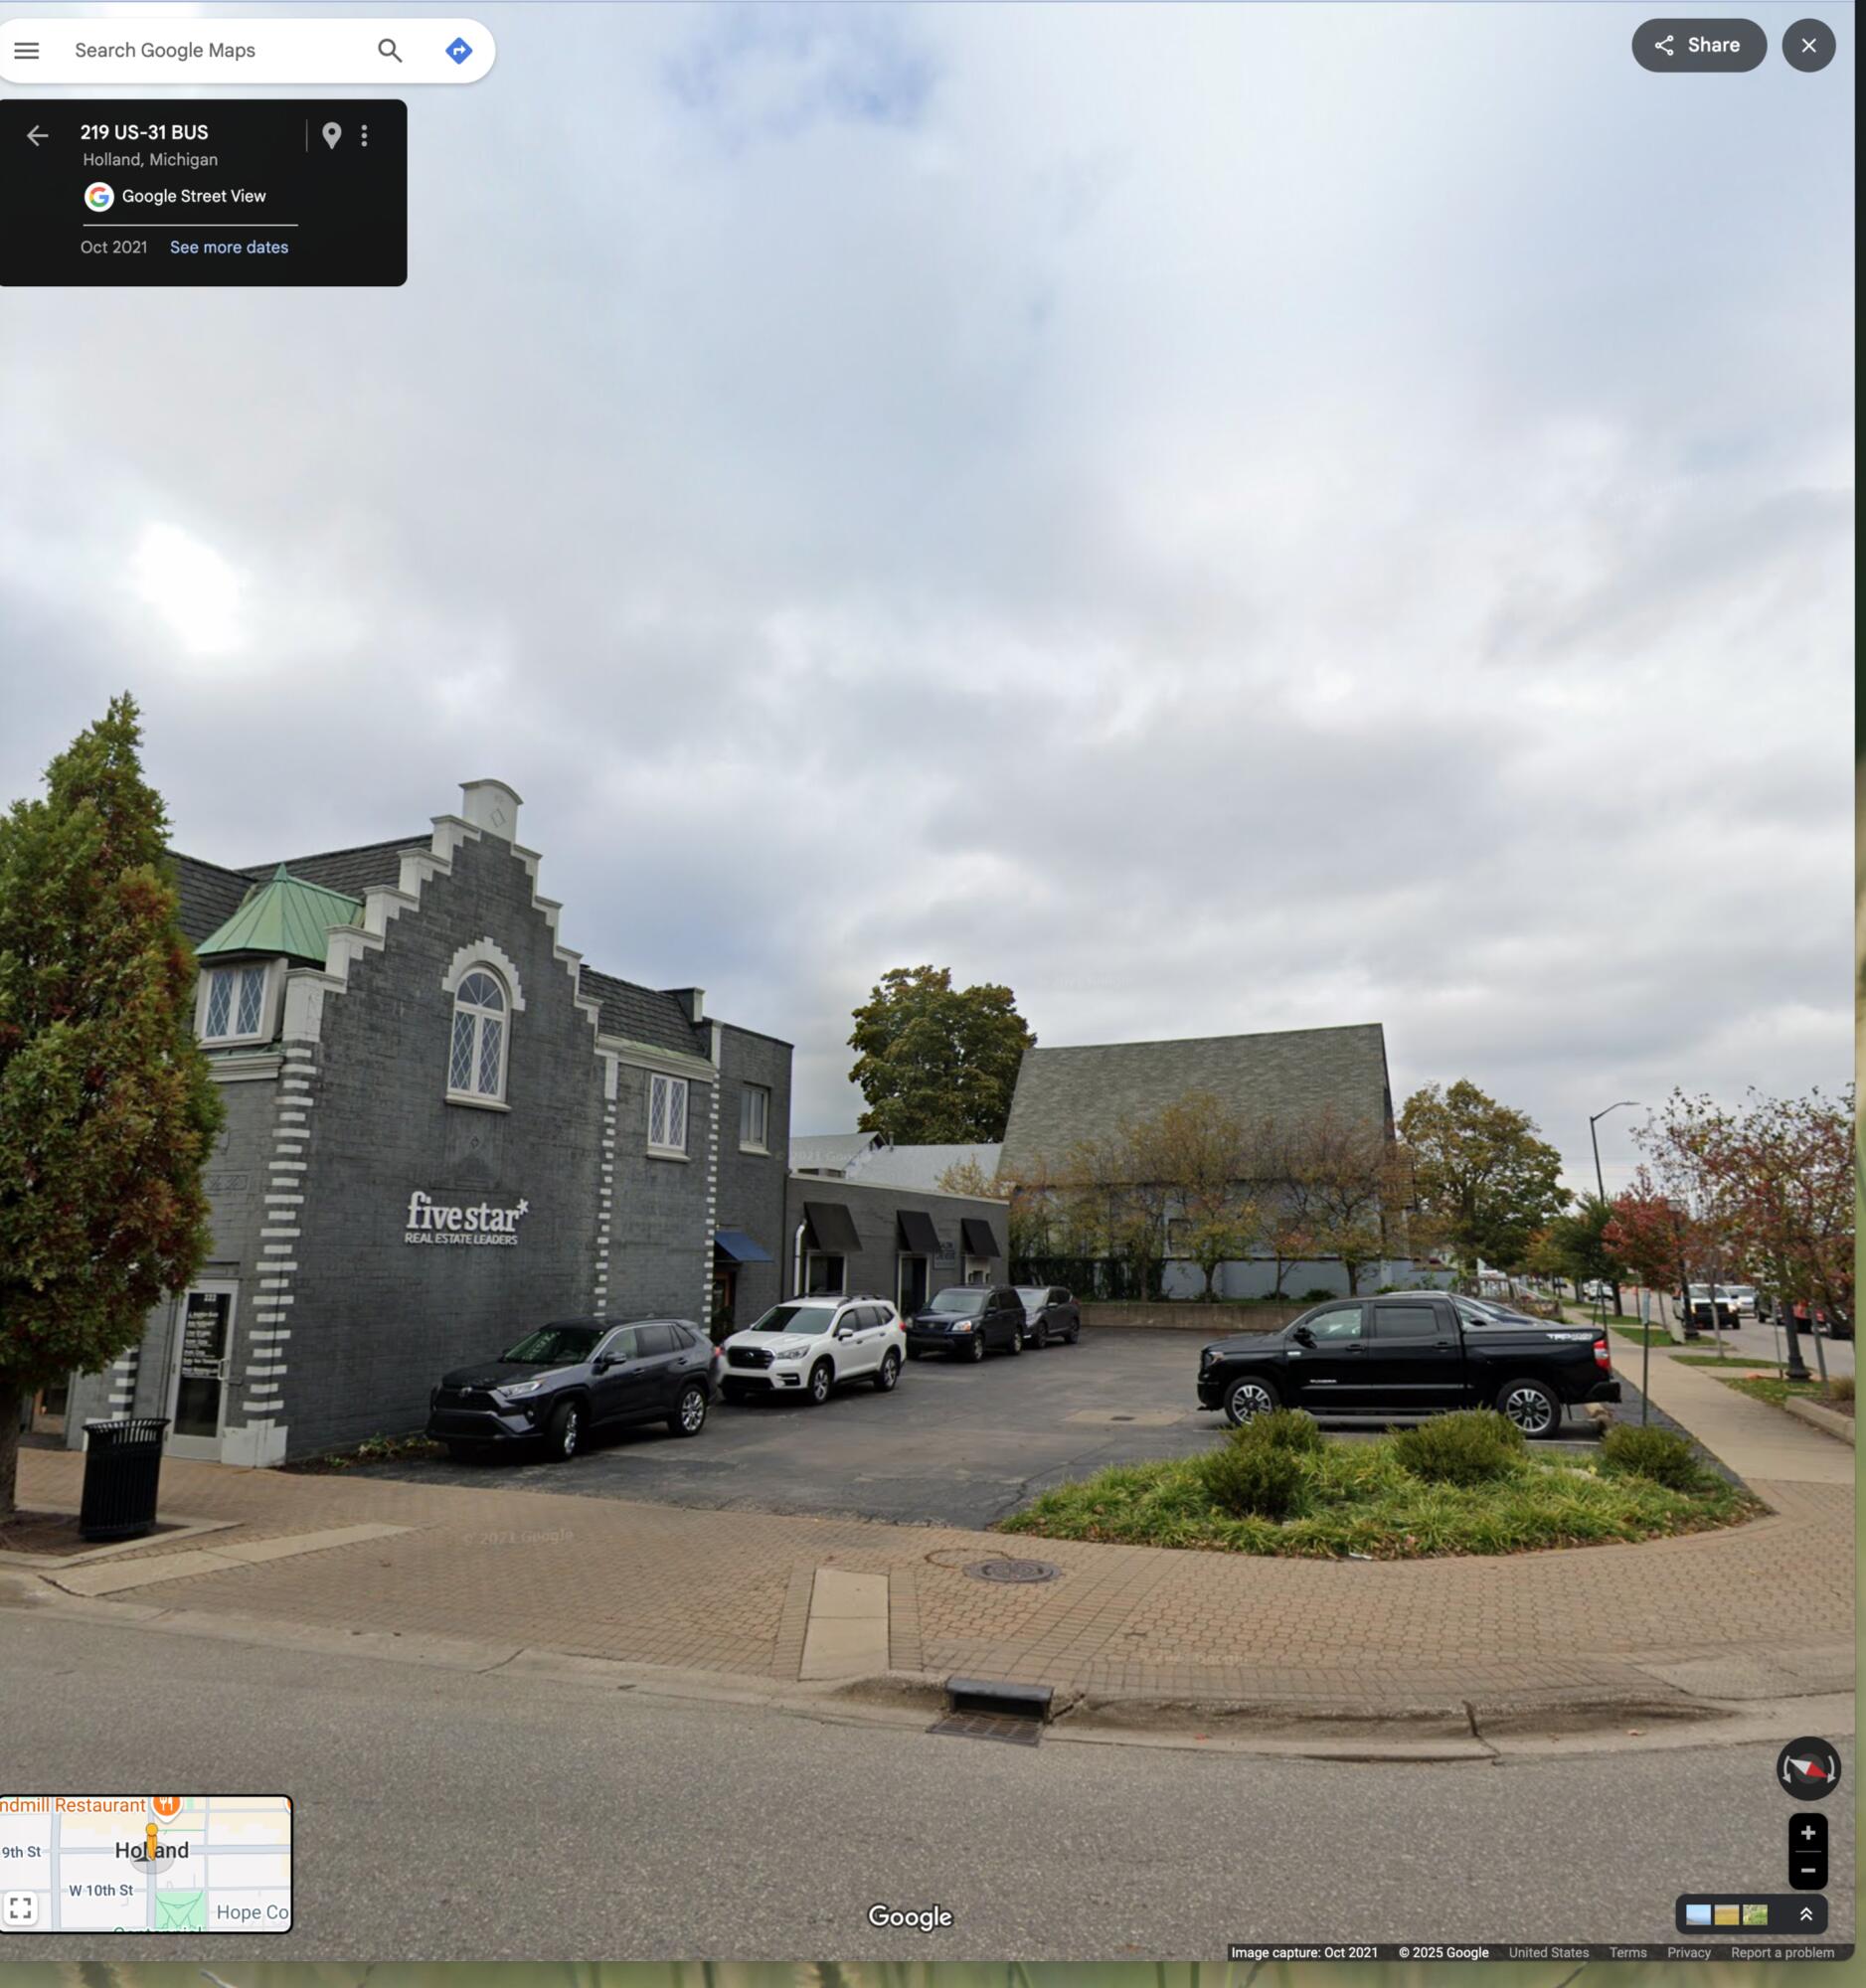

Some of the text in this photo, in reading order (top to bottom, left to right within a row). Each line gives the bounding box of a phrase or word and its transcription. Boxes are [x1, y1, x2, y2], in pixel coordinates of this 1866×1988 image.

[405, 1232, 518, 1245] REAL ESTATE LEADERS
